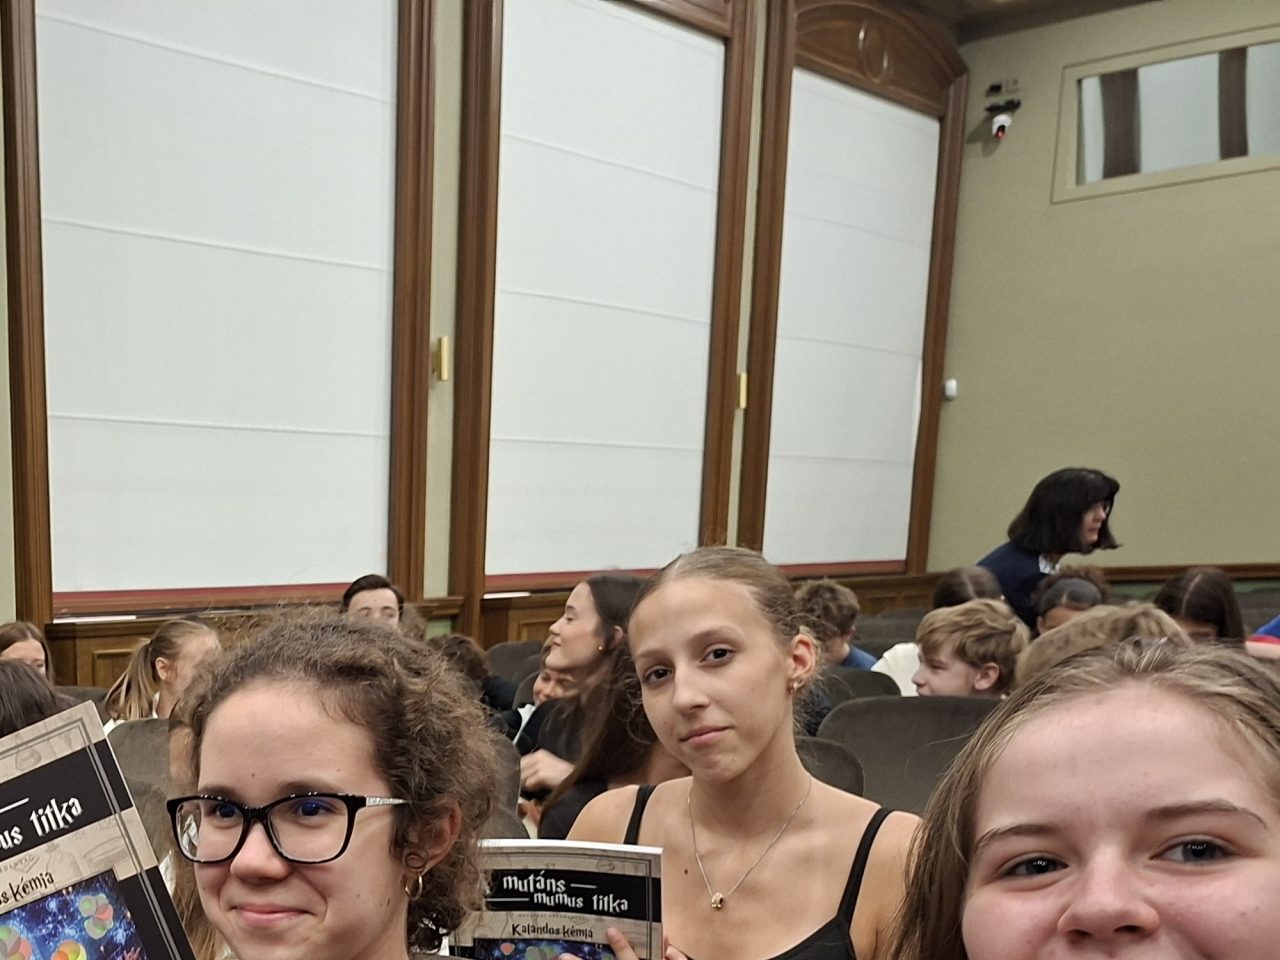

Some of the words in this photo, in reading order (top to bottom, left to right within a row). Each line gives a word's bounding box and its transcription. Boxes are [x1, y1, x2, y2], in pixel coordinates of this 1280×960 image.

[29, 797, 82, 837] titka
[9, 871, 54, 902] kémia
[502, 870, 566, 893] mutáns
[533, 891, 584, 909] mumus
[592, 894, 629, 914] titka
[512, 923, 560, 936] Kalandos
